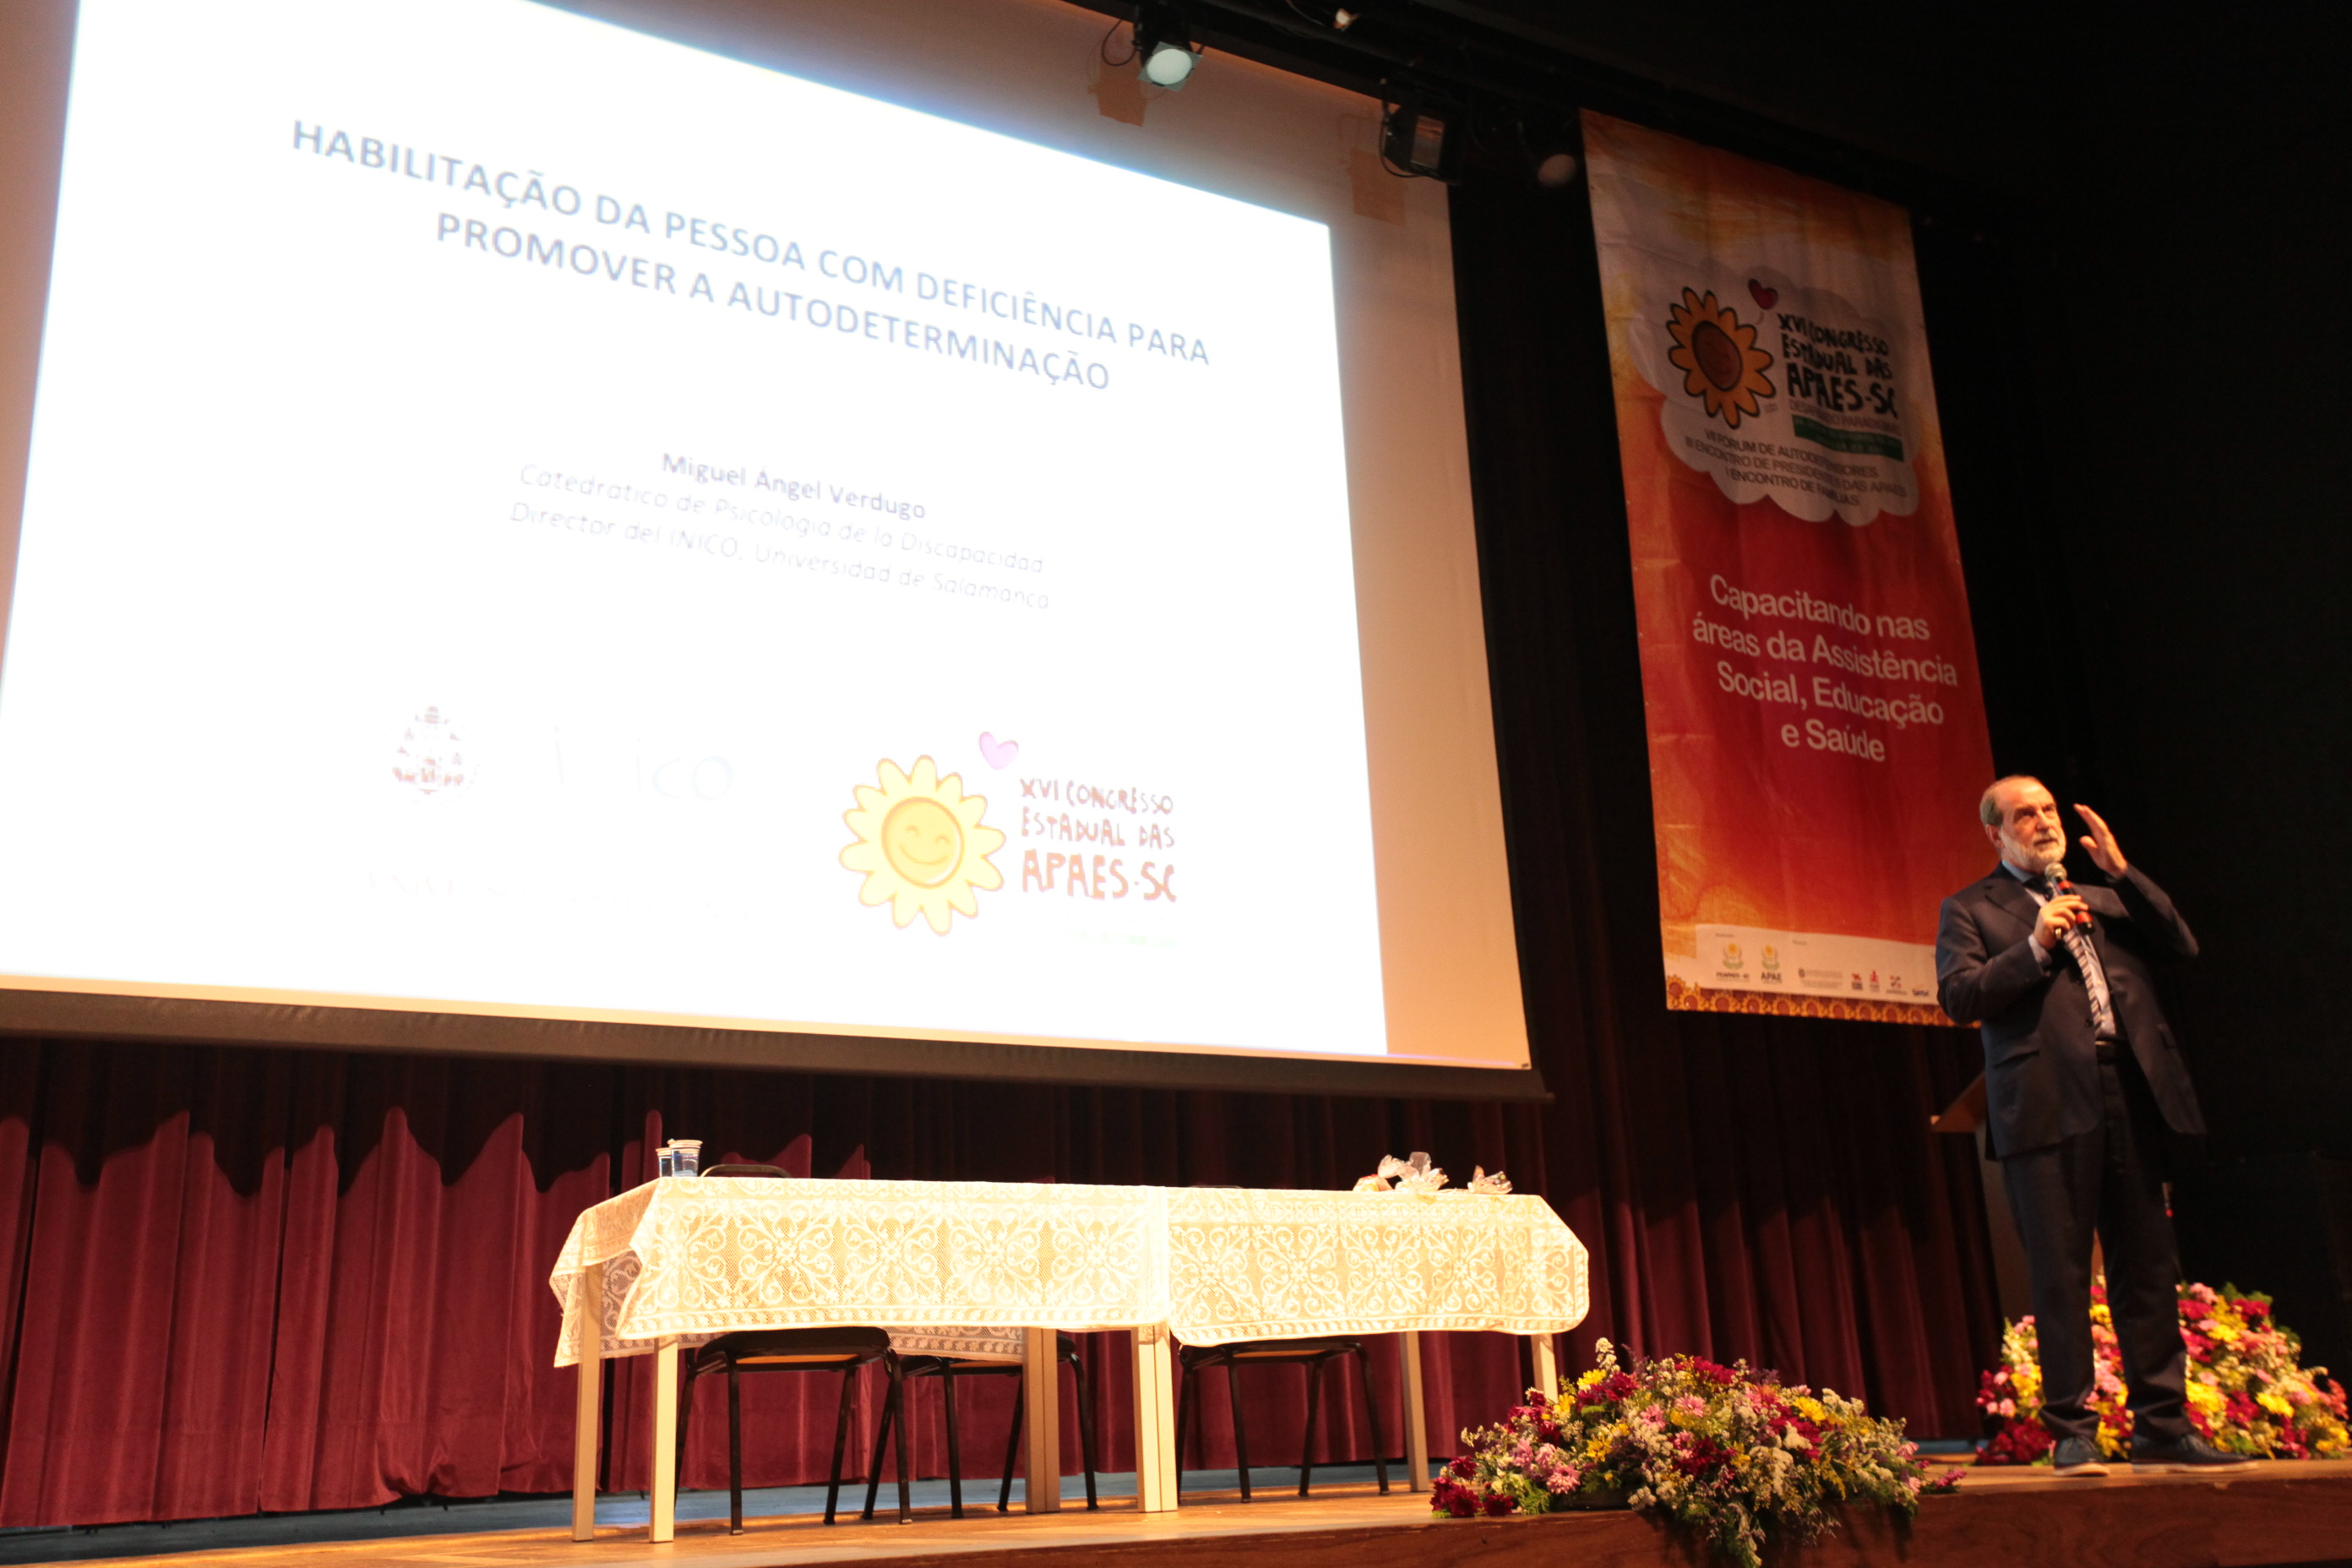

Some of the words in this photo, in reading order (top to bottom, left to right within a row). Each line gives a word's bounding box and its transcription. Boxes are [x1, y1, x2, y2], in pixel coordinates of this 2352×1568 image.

[292, 120, 582, 216] HABILITAÇÃO
[596, 194, 651, 235] DA
[666, 211, 805, 271] PESSOA
[819, 249, 904, 294] COM
[917, 272, 1117, 344] DEFICIÊNCIA
[1128, 322, 1210, 366] PARA
[437, 212, 677, 295] PROMOVER
[689, 273, 715, 303] A
[727, 281, 1110, 390] AUTODETERMINAÇÃO
[1778, 313, 1807, 336] XVI
[1809, 321, 1889, 356] CONGRESSO
[1781, 332, 1858, 375] ESTADUAL
[1865, 357, 1893, 379] DAS
[661, 452, 747, 485] Miguel
[829, 483, 927, 521] Verdugo
[1752, 456, 1772, 470] DE
[1757, 442, 1775, 455] DE
[1778, 444, 1879, 478] AUTODESORES
[1799, 478, 1816, 493] DE
[509, 501, 617, 536] Director
[623, 522, 662, 544] del
[754, 543, 892, 583] Universidad
[898, 569, 926, 587] de
[933, 572, 1050, 610] Salamanca
[676, 493, 706, 514] de
[838, 522, 867, 542] de
[874, 525, 894, 547] la
[901, 531, 1044, 574] Discapacidad
[1710, 574, 1871, 635] Capacitando
[1876, 614, 1931, 641] nas
[1692, 610, 1761, 658] áreas
[1766, 629, 1807, 662] da
[1811, 634, 1959, 688] Assistência
[1716, 660, 1808, 710] Social,
[1812, 676, 1945, 730] Educação
[1780, 722, 1800, 749] e
[1805, 718, 1886, 762] Saúde
[1019, 776, 1060, 803] XVI
[1065, 779, 1175, 816] CONGRESSO
[1020, 805, 1127, 848] ESTADUAL
[1138, 821, 1176, 851] DAS
